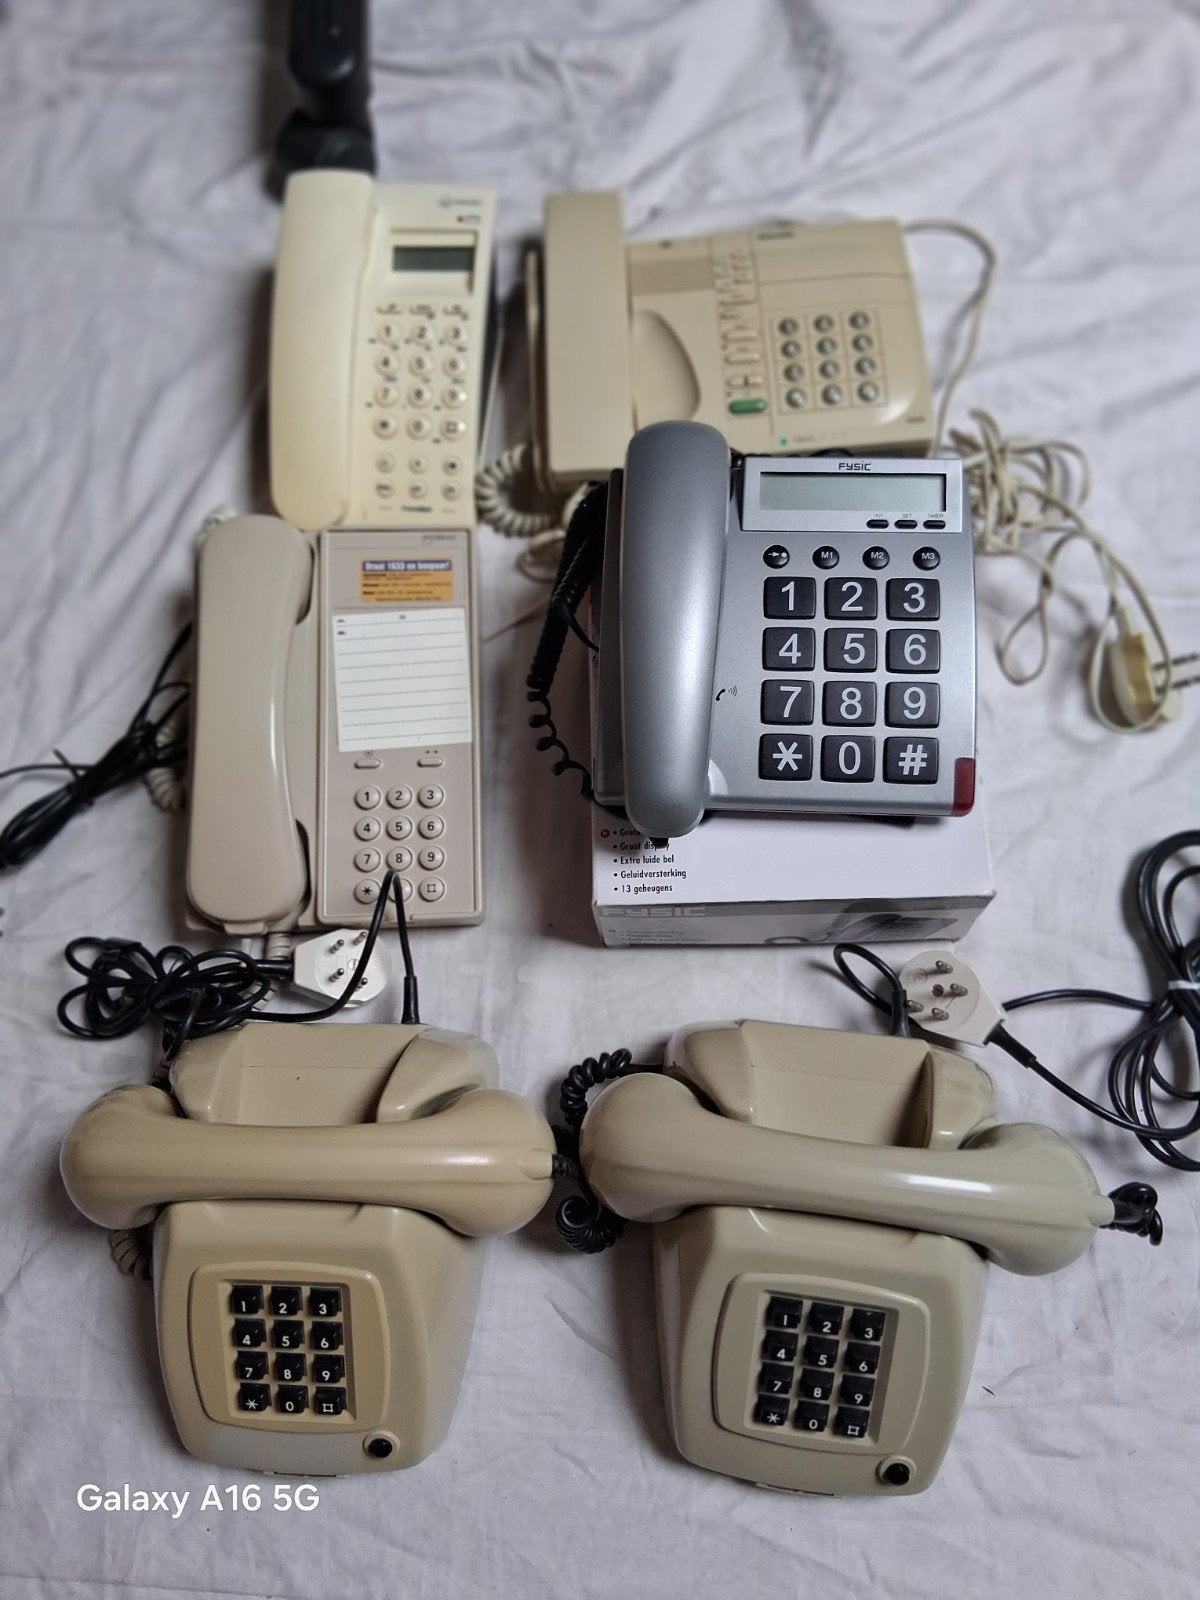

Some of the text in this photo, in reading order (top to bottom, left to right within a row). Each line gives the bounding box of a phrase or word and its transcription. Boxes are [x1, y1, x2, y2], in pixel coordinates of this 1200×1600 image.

[821, 551, 936, 561] M1 M2 M3
[781, 581, 926, 613] 1 2 3
[778, 633, 927, 665] 4 5 6
[780, 686, 926, 720] 7 8 9
[838, 741, 861, 775] 0
[898, 744, 928, 776] #
[364, 790, 434, 802] 1 2 3
[363, 821, 435, 833] 4 5 6
[364, 851, 435, 864] 7 8 9
[620, 854, 675, 864] Extra luide bel
[620, 869, 687, 879] Geluidversterking
[621, 884, 673, 895] 13 geheugens
[241, 1301, 327, 1315] 1 2 3
[783, 1315, 873, 1339] 1 2 3
[242, 1334, 329, 1348] 4 5 6
[776, 1348, 868, 1372] 4 5 6
[244, 1367, 330, 1381] 7 8 9
[773, 1381, 863, 1404] 7 8 9
[285, 1401, 294, 1411] 0
[808, 1419, 818, 1429] 0
